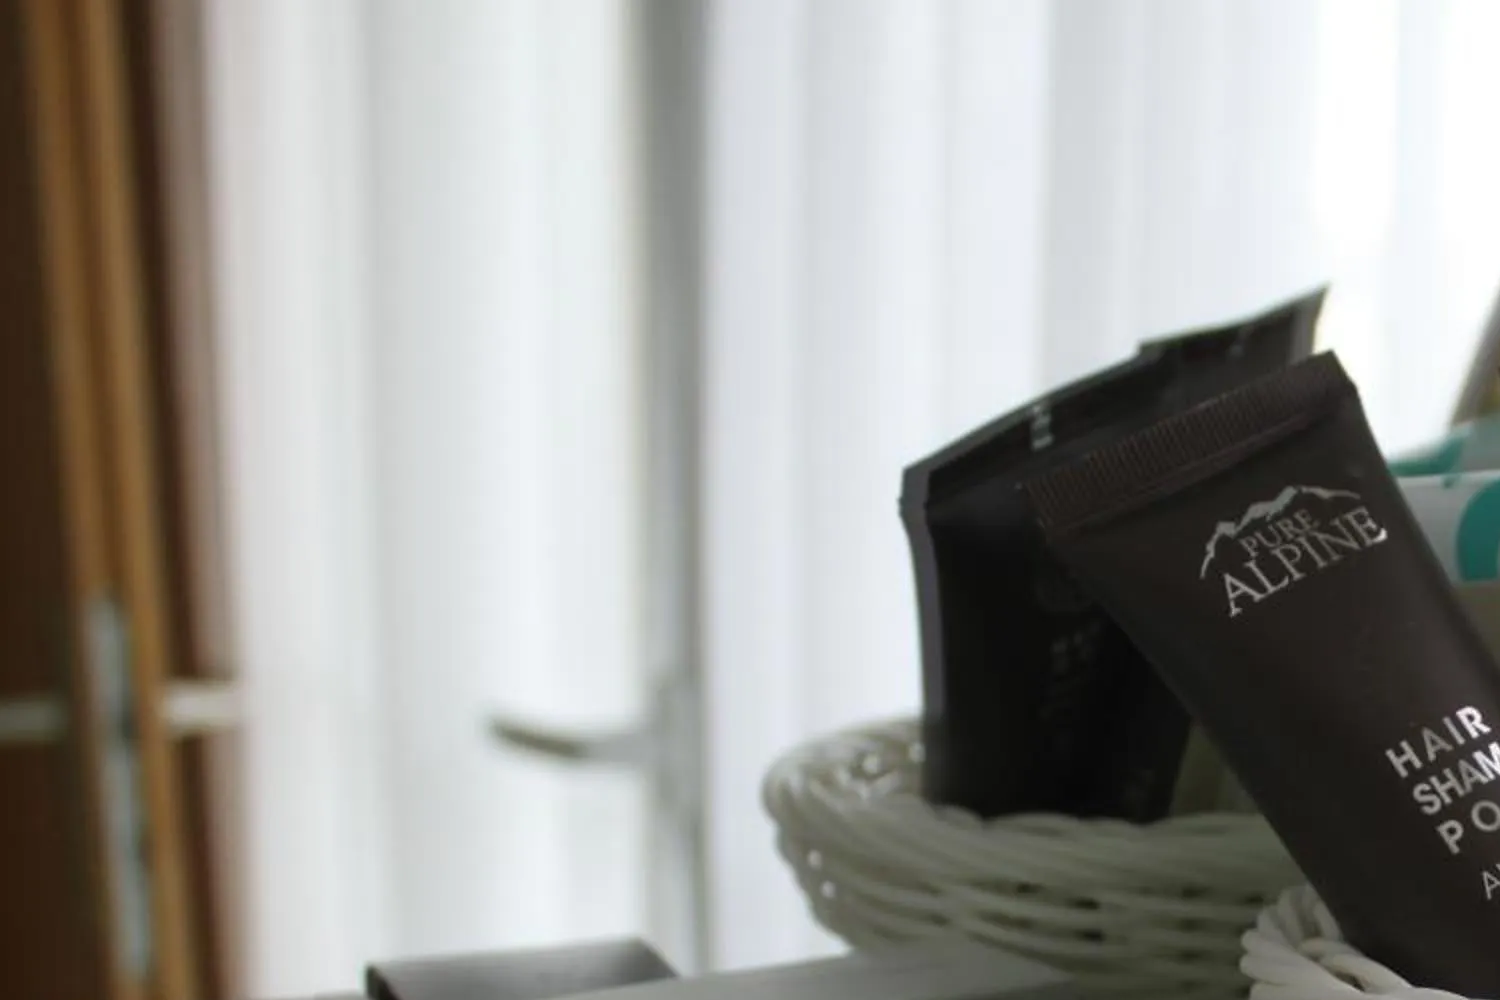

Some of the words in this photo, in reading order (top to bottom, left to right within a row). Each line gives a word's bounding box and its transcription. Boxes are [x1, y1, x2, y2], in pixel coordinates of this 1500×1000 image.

[1223, 505, 1388, 619] ALPINE
[1240, 508, 1321, 557] PURE
[1386, 705, 1491, 779] HAIR
